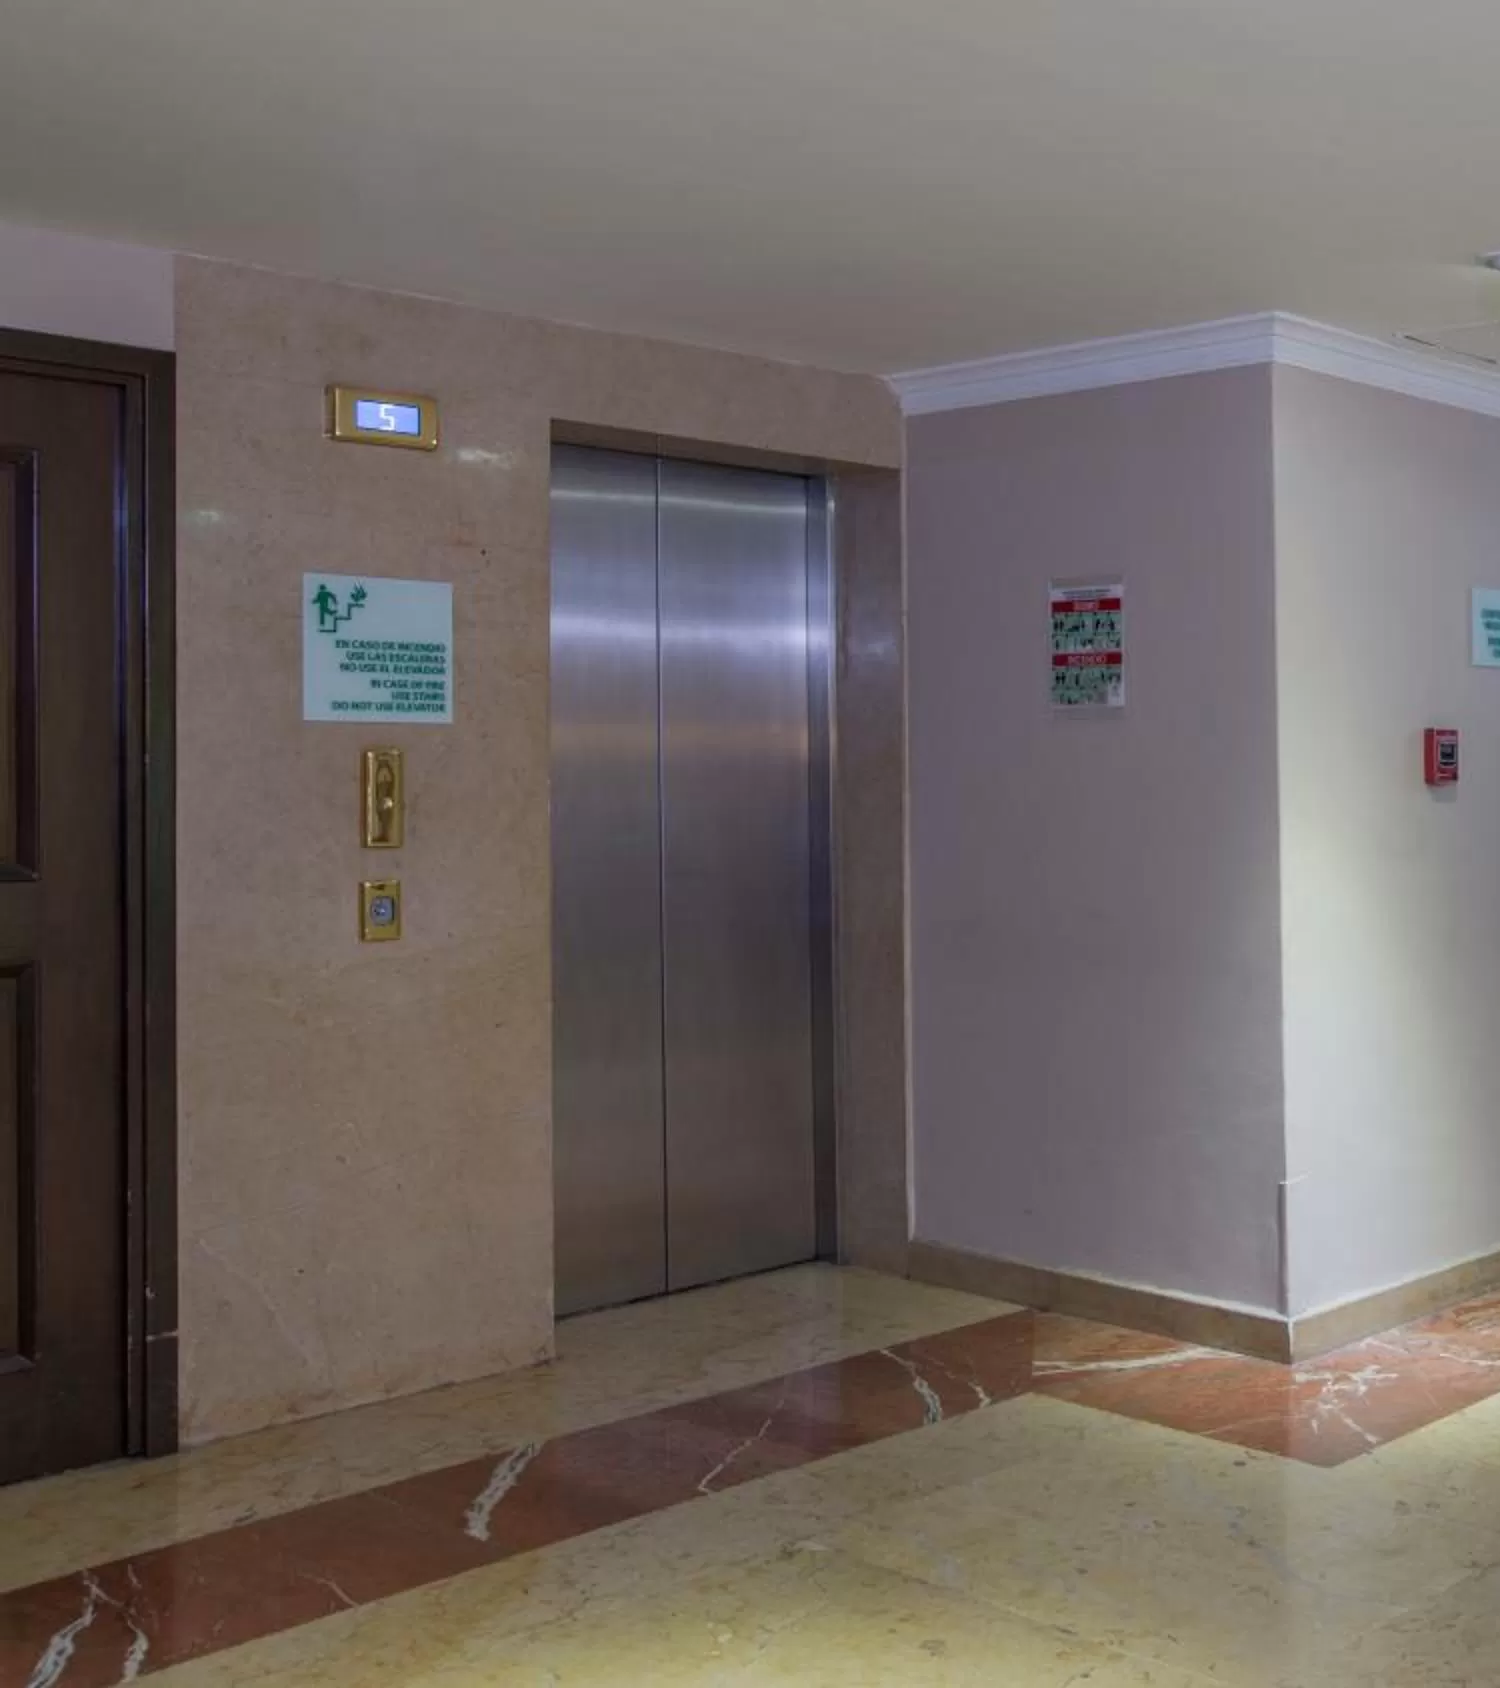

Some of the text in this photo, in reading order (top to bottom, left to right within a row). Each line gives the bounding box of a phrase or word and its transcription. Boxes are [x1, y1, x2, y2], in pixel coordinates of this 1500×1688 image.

[335, 639, 446, 653] EN CASO DE INCENDIO
[346, 650, 446, 664] USE LAS ESCALERAS
[339, 663, 446, 675] NO USE EL ELEVADOR
[370, 679, 446, 690] IN CASE OF FIRE
[391, 691, 446, 702] USE STAIRS
[331, 701, 446, 713] DO NOT USE ELEVATOR
